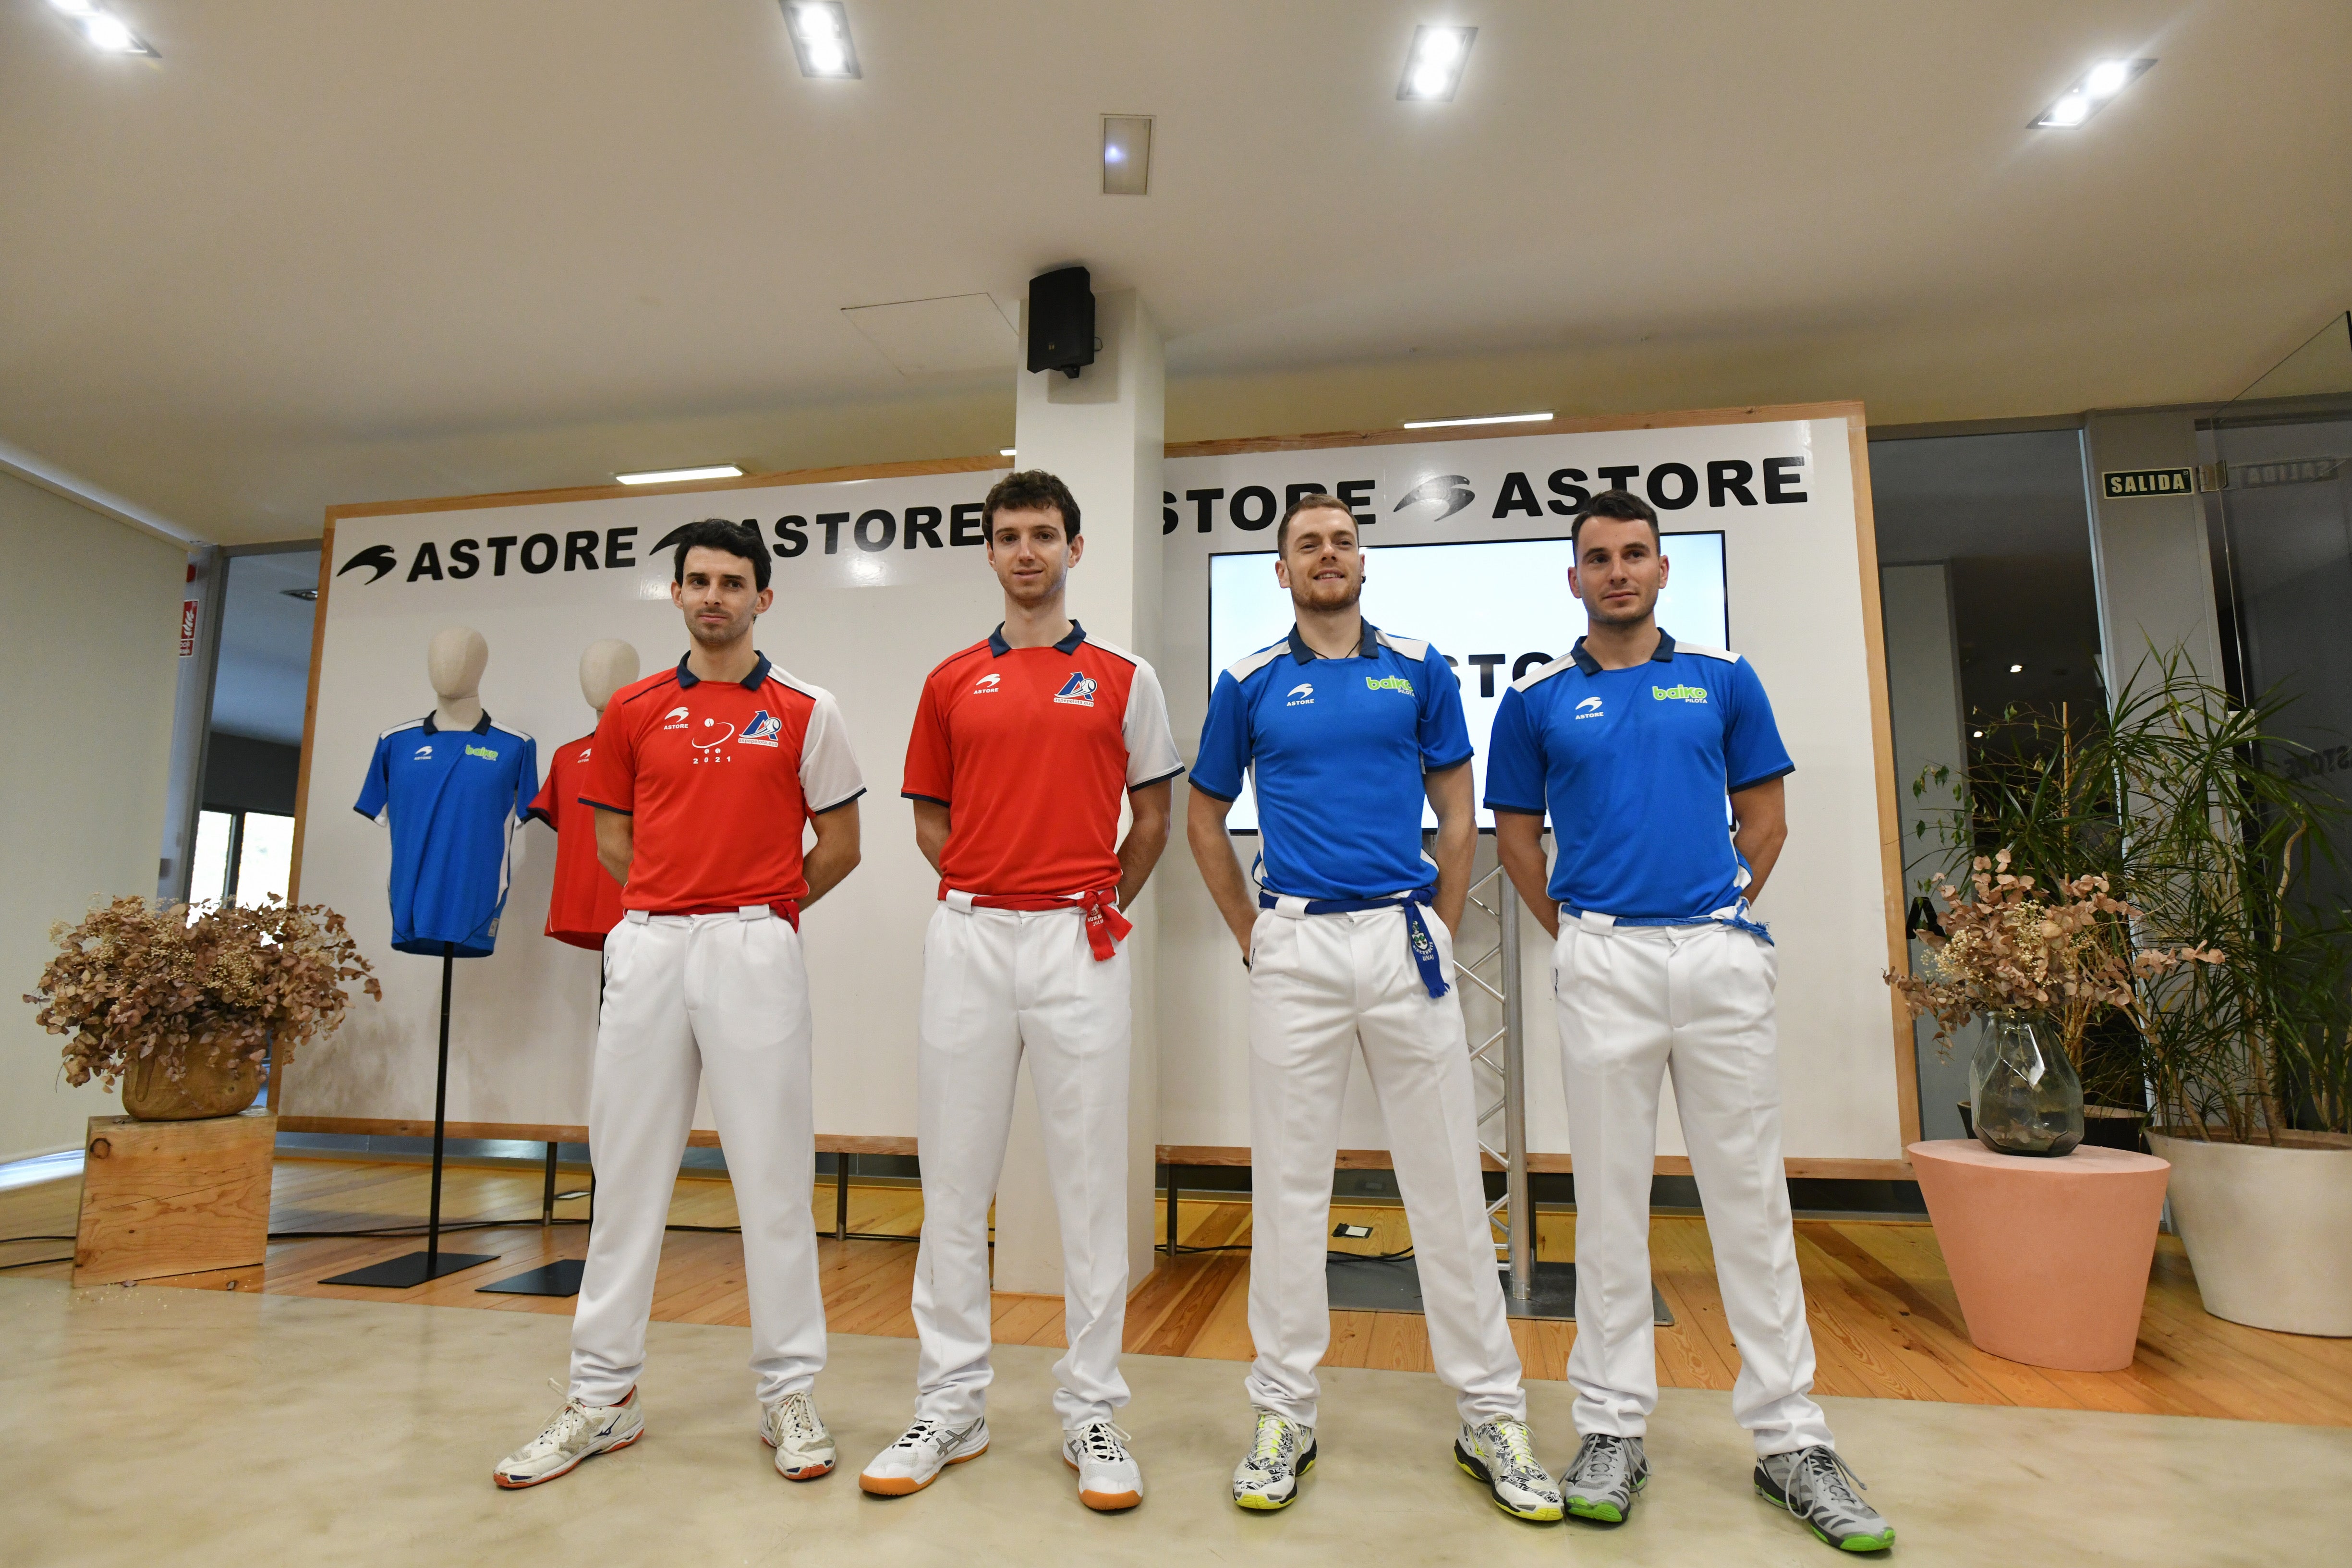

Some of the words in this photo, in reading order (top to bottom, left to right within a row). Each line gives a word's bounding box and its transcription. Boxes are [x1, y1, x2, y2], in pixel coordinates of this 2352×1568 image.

[1492, 456, 1808, 519] ASTORE
[2110, 473, 2185, 493] SALIDA
[741, 502, 985, 558] STORE
[406, 526, 638, 582] ASTORE
[1398, 689, 1416, 697] PILOTA
[1652, 684, 1708, 701] baiko
[1054, 698, 1094, 706] aspepelota.eus
[1576, 712, 1604, 720] ASTORE
[739, 738, 778, 747] aspepelota.eus
